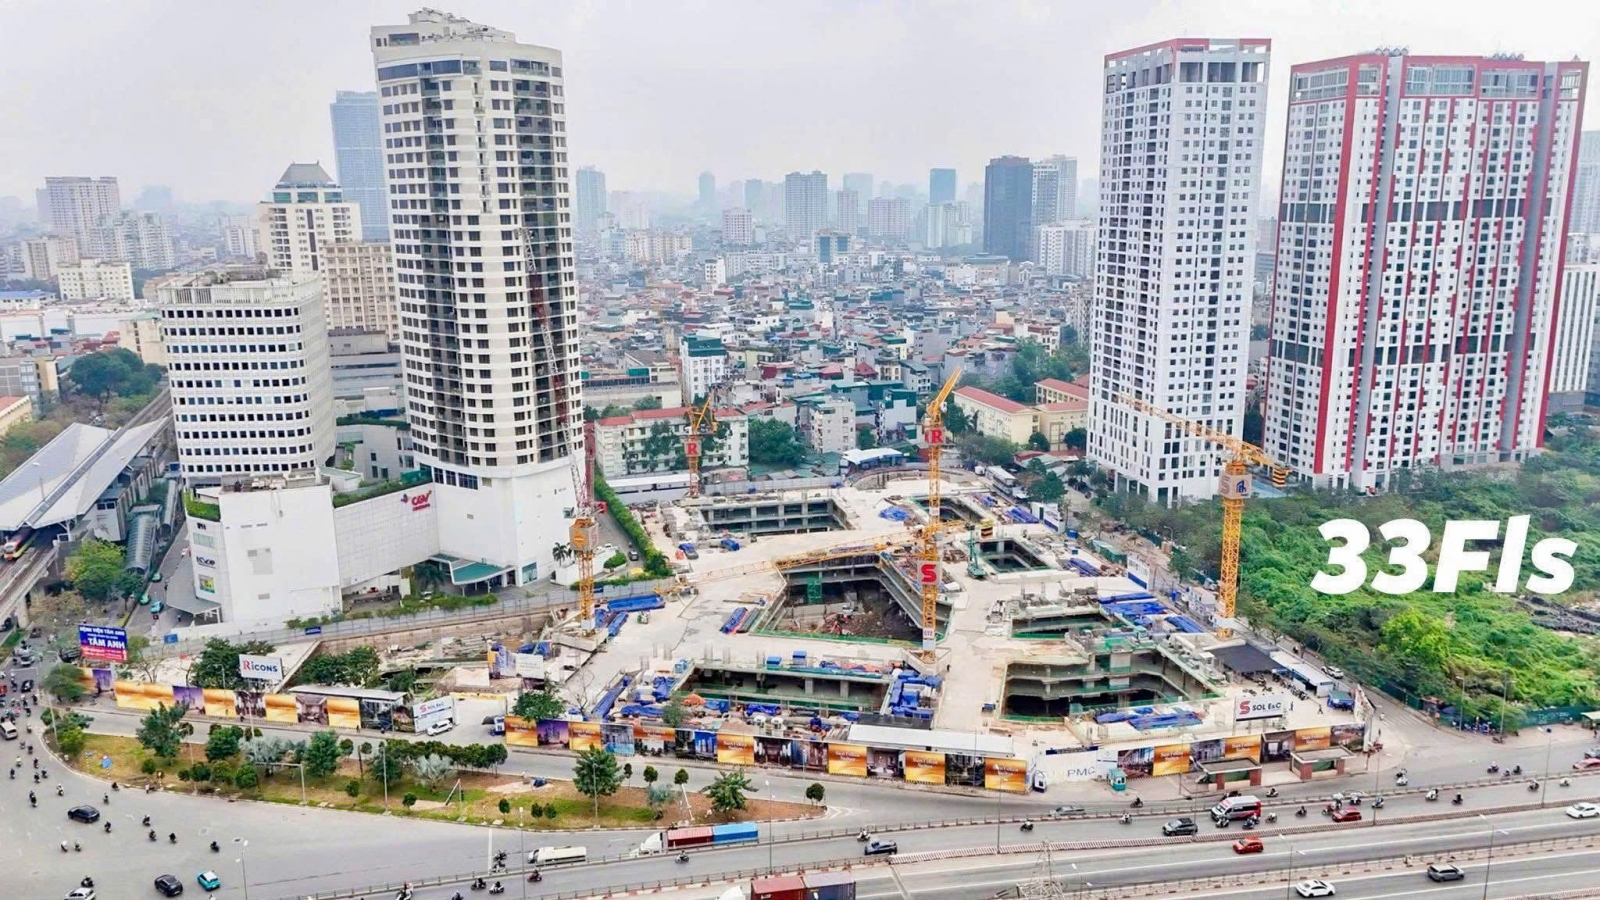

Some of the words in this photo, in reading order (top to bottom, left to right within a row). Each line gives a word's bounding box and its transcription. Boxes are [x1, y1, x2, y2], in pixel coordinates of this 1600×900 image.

[931, 430, 943, 443] R
[687, 443, 698, 455] R
[921, 564, 937, 582] S
[107, 640, 125, 649] ANH
[1067, 766, 1096, 777] PMC
